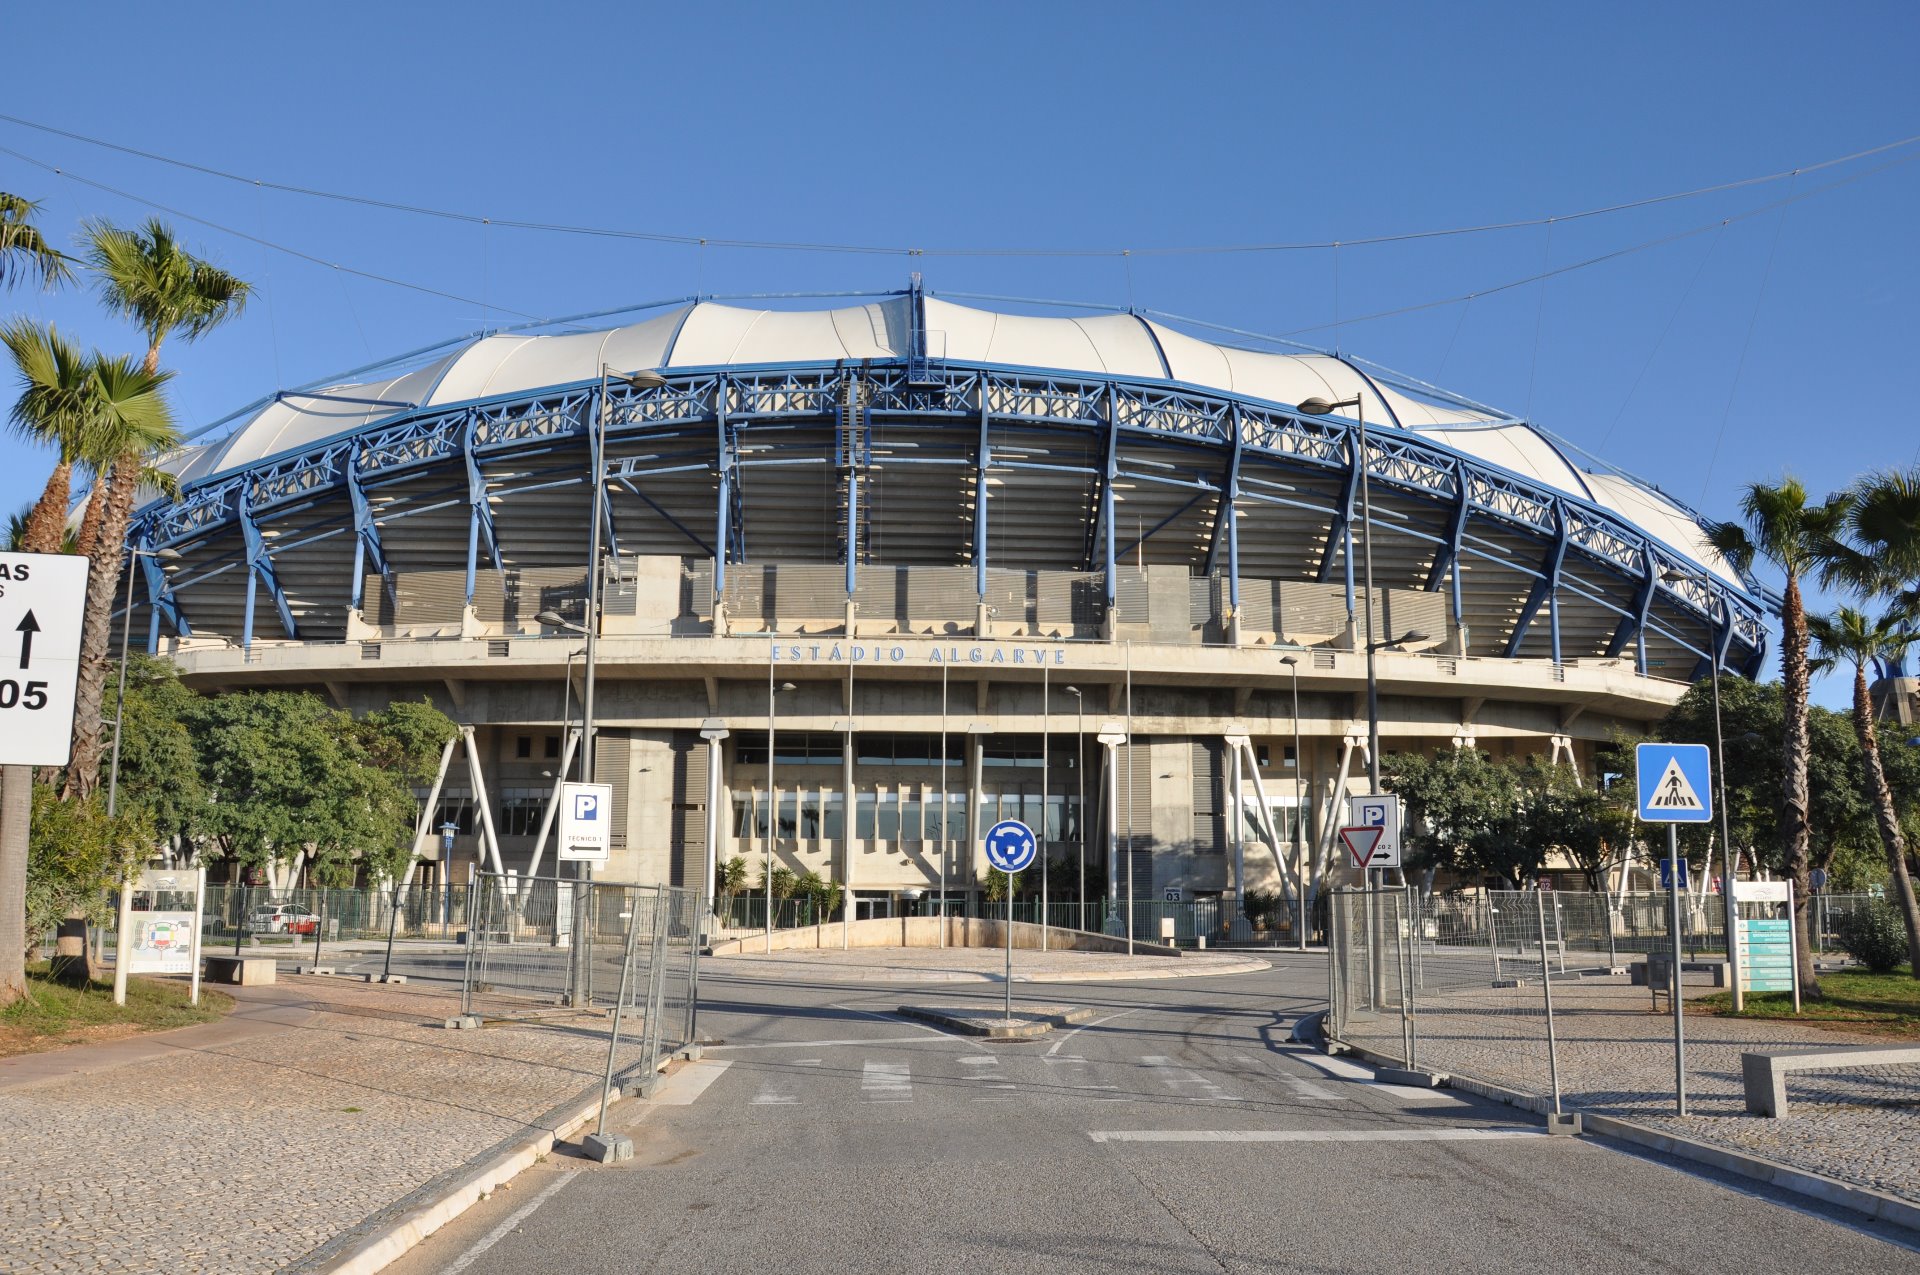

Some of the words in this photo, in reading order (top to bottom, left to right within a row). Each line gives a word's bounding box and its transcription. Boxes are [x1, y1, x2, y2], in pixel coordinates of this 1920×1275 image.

[772, 642, 904, 663] ESTÁDIO
[928, 647, 1065, 665] ALGARVE
[576, 796, 596, 819] P
[1365, 806, 1383, 826] P
[1540, 882, 1551, 891] 02
[1166, 893, 1180, 902] 03
